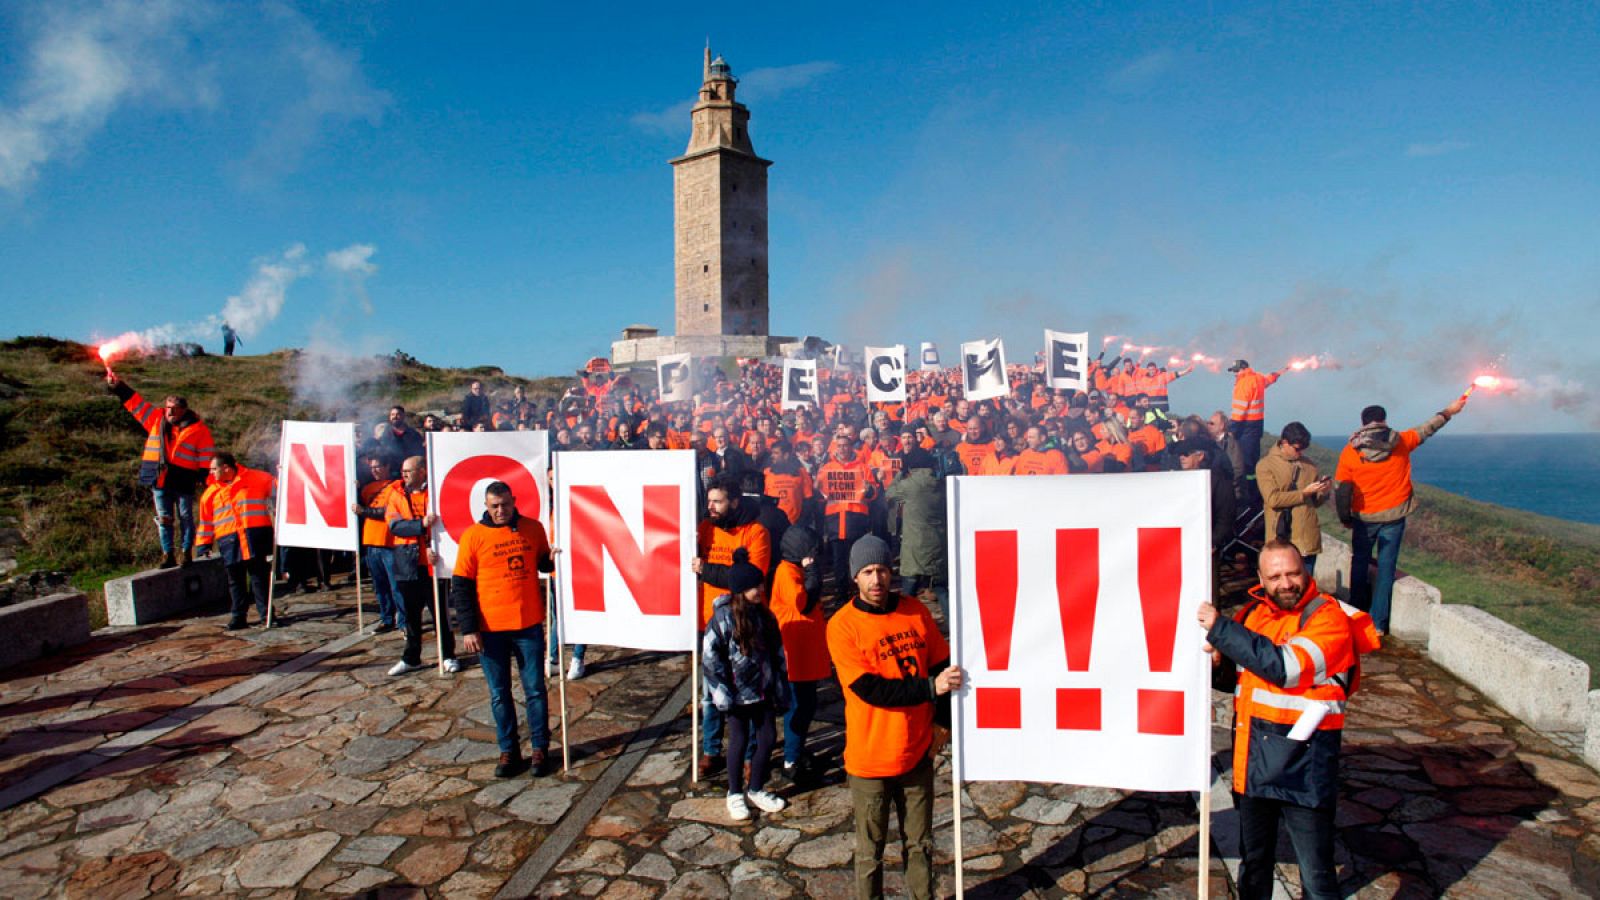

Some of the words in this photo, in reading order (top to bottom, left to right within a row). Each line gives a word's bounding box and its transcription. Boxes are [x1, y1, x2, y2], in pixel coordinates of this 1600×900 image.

[662, 362, 689, 394] P
[870, 355, 901, 392] C
[1053, 340, 1082, 380] E
[788, 367, 815, 401] E
[286, 443, 348, 528] N
[439, 454, 541, 545] O
[569, 485, 681, 616] N
